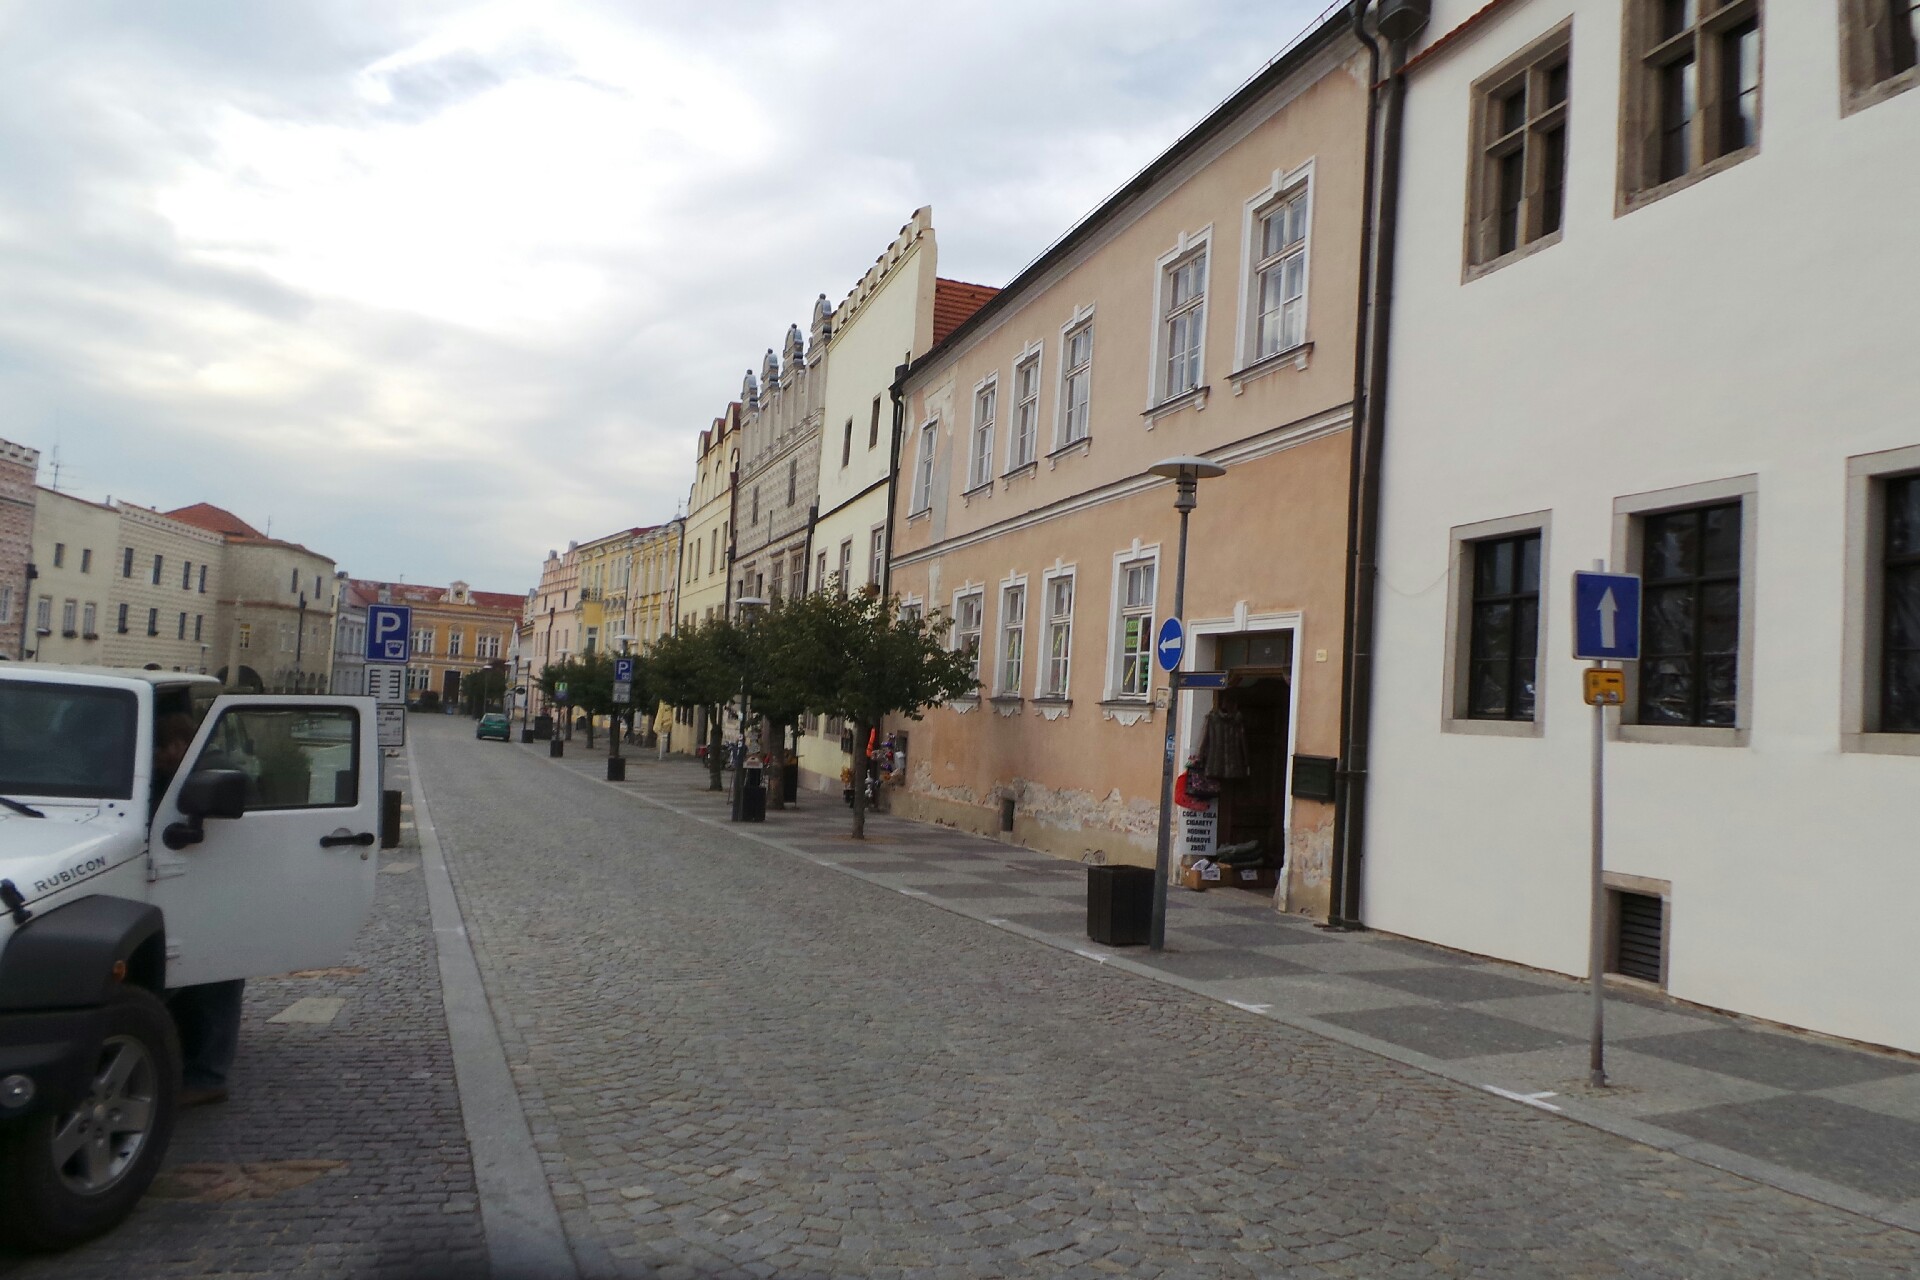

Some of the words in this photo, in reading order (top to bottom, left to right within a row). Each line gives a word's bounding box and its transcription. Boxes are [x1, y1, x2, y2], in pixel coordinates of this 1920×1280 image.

[375, 611, 401, 644] P
[618, 661, 629, 675] P
[34, 856, 106, 892] RUBICON
